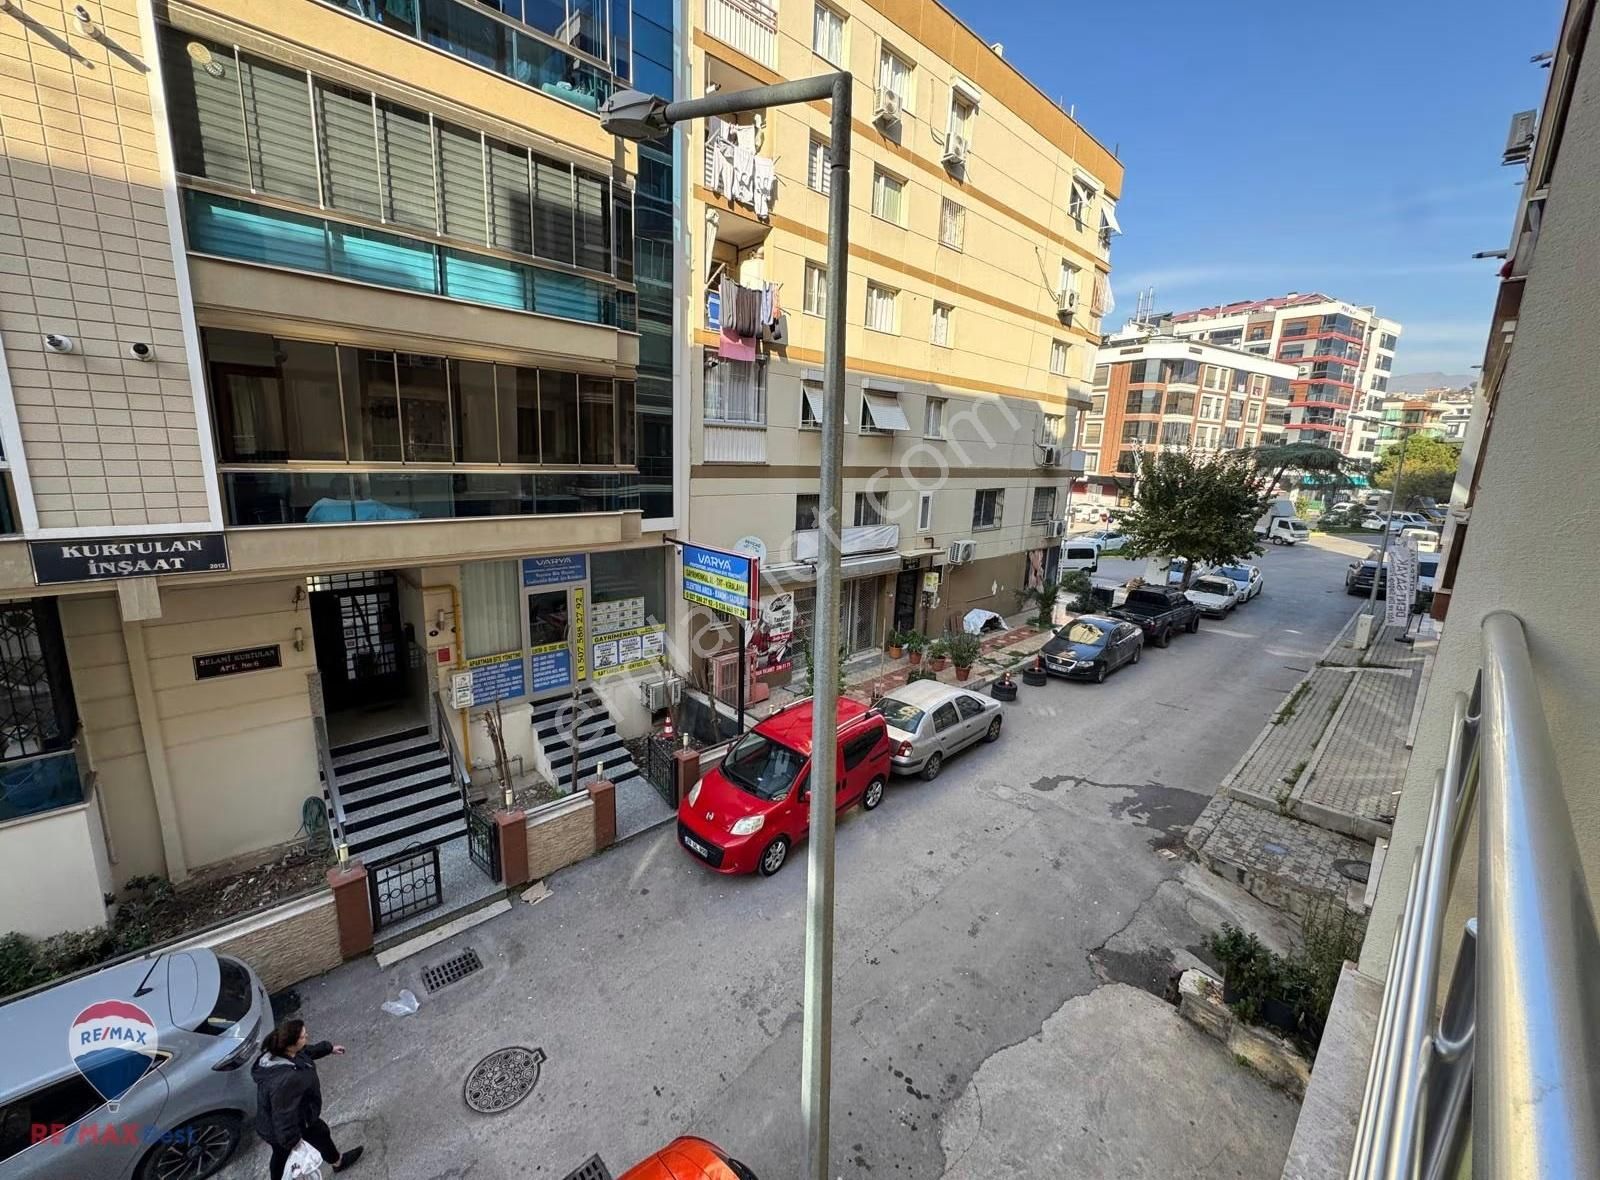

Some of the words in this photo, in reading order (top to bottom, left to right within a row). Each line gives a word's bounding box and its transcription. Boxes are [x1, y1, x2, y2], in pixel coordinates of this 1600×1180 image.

[60, 540, 203, 559] KURTULAN
[88, 557, 185, 575] İNŞAAT
[536, 557, 572, 566] VARYA
[698, 553, 732, 571] VARYA
[576, 598, 583, 609] 92
[576, 612, 584, 623] 27
